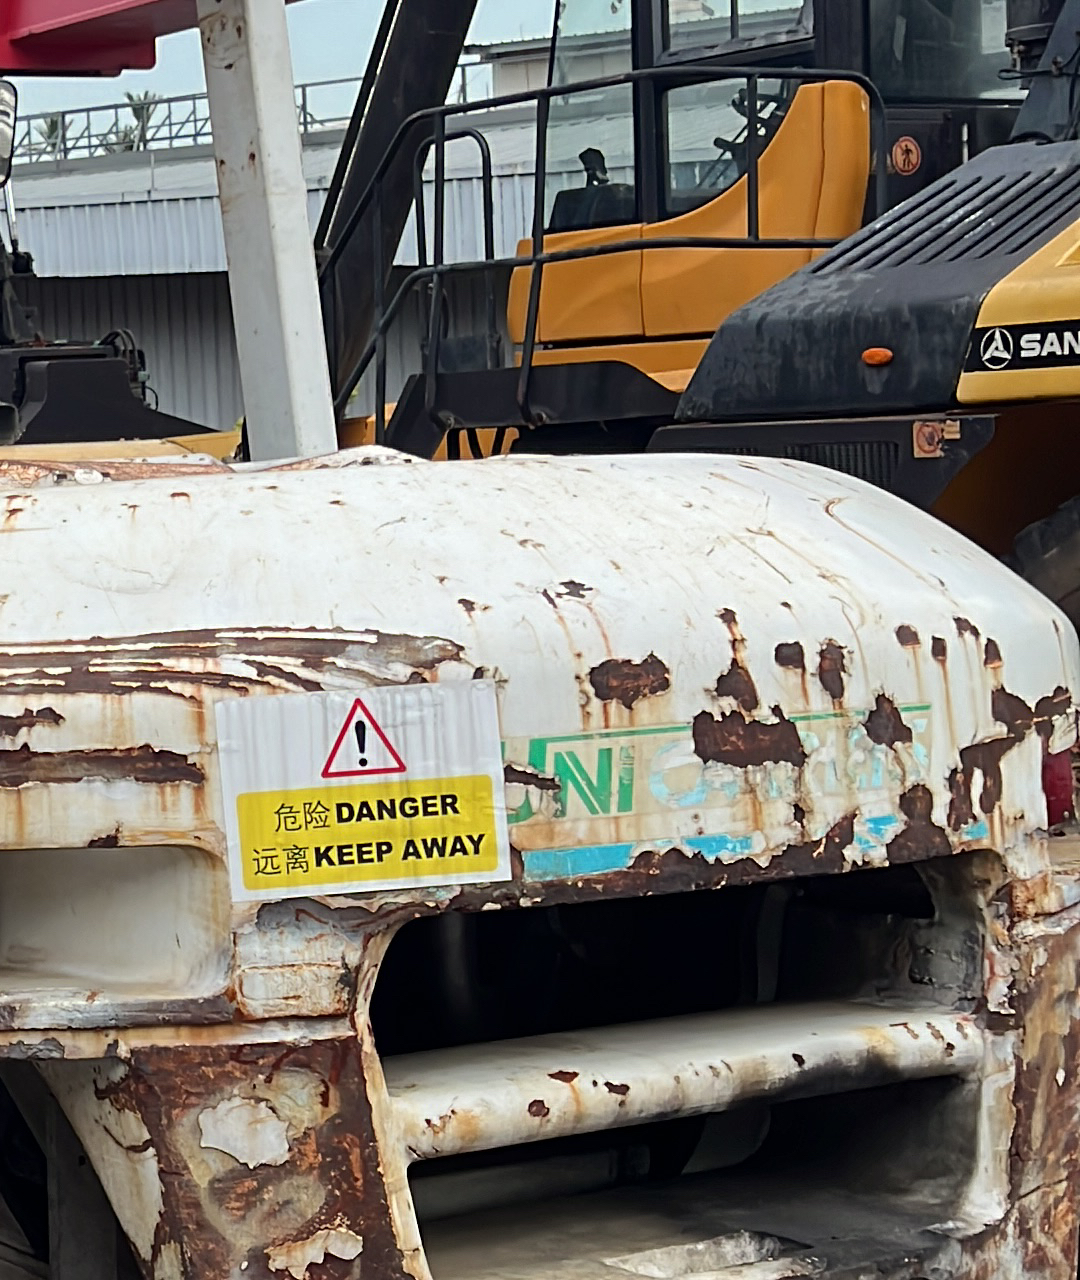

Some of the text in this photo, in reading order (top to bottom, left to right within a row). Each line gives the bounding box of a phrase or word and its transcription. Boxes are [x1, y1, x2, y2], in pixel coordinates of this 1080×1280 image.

[274, 794, 460, 833] 危险 DANGER
[252, 833, 486, 876] 远离 KEEP AWAY
